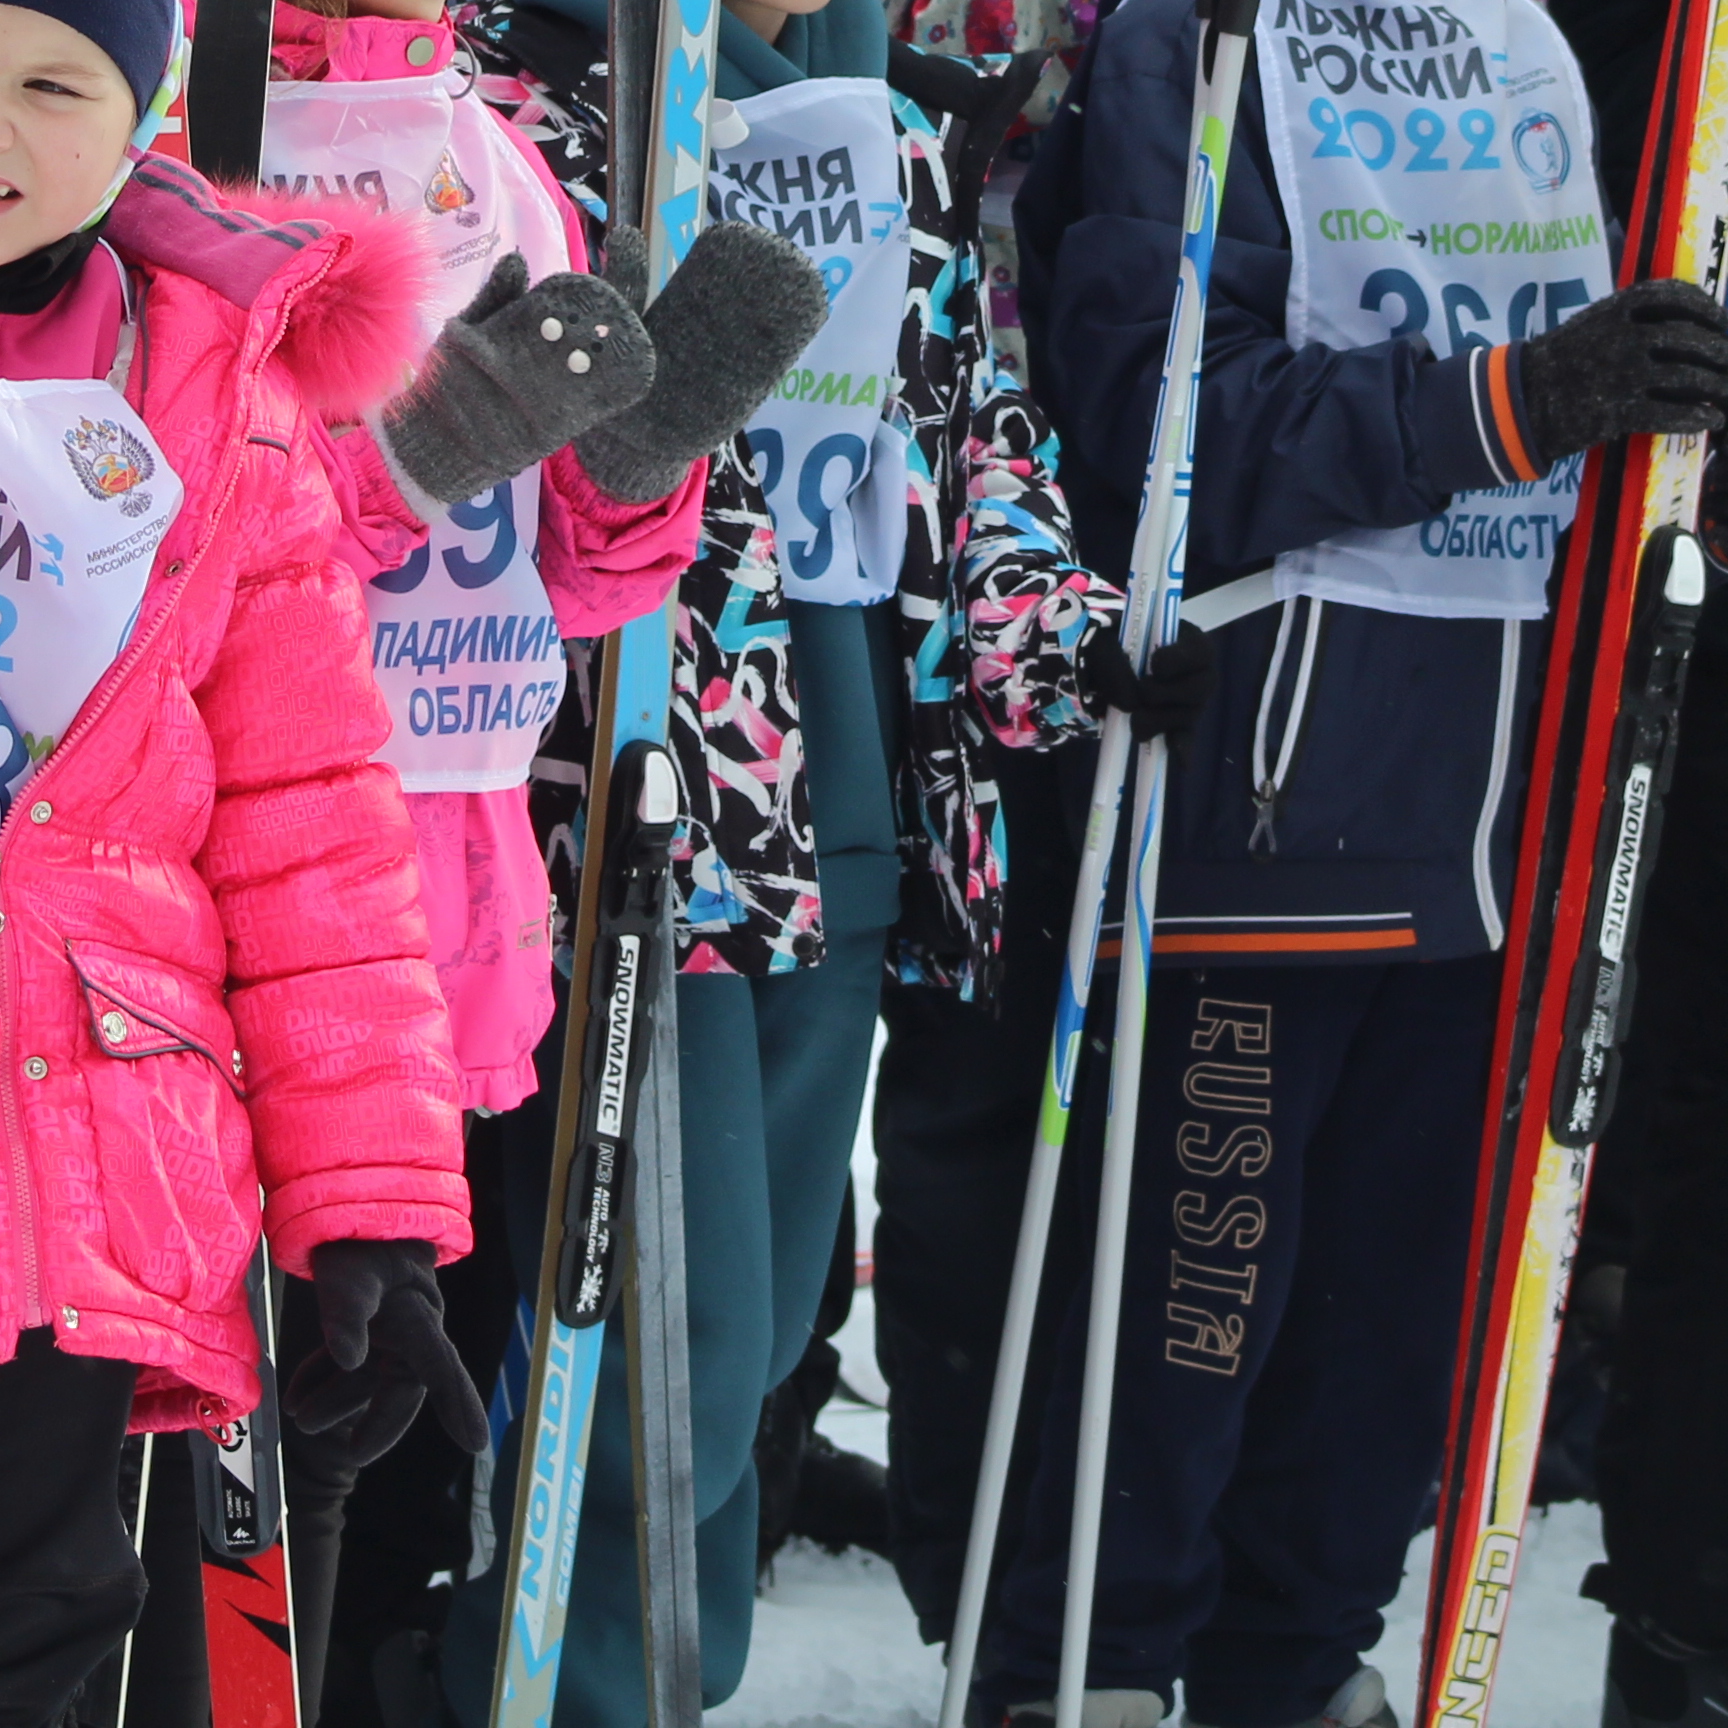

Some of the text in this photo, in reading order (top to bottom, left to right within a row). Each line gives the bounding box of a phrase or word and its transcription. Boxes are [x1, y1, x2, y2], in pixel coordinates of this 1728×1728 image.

[1287, 35, 1495, 99] РОССИИ
[1308, 98, 1501, 173] 2022
[409, 682, 557, 737] ОБЛАСТЬ
[1605, 778, 1647, 946] SNOWMATIC
[602, 947, 637, 1122] SNOWMATIC
[595, 1142, 615, 1184] N3
[585, 1185, 603, 1264] TECHNOLOGY
[599, 1189, 610, 1222] AUTO
[556, 1463, 585, 1609] COMBI
[1436, 1530, 1521, 1728] NCED
